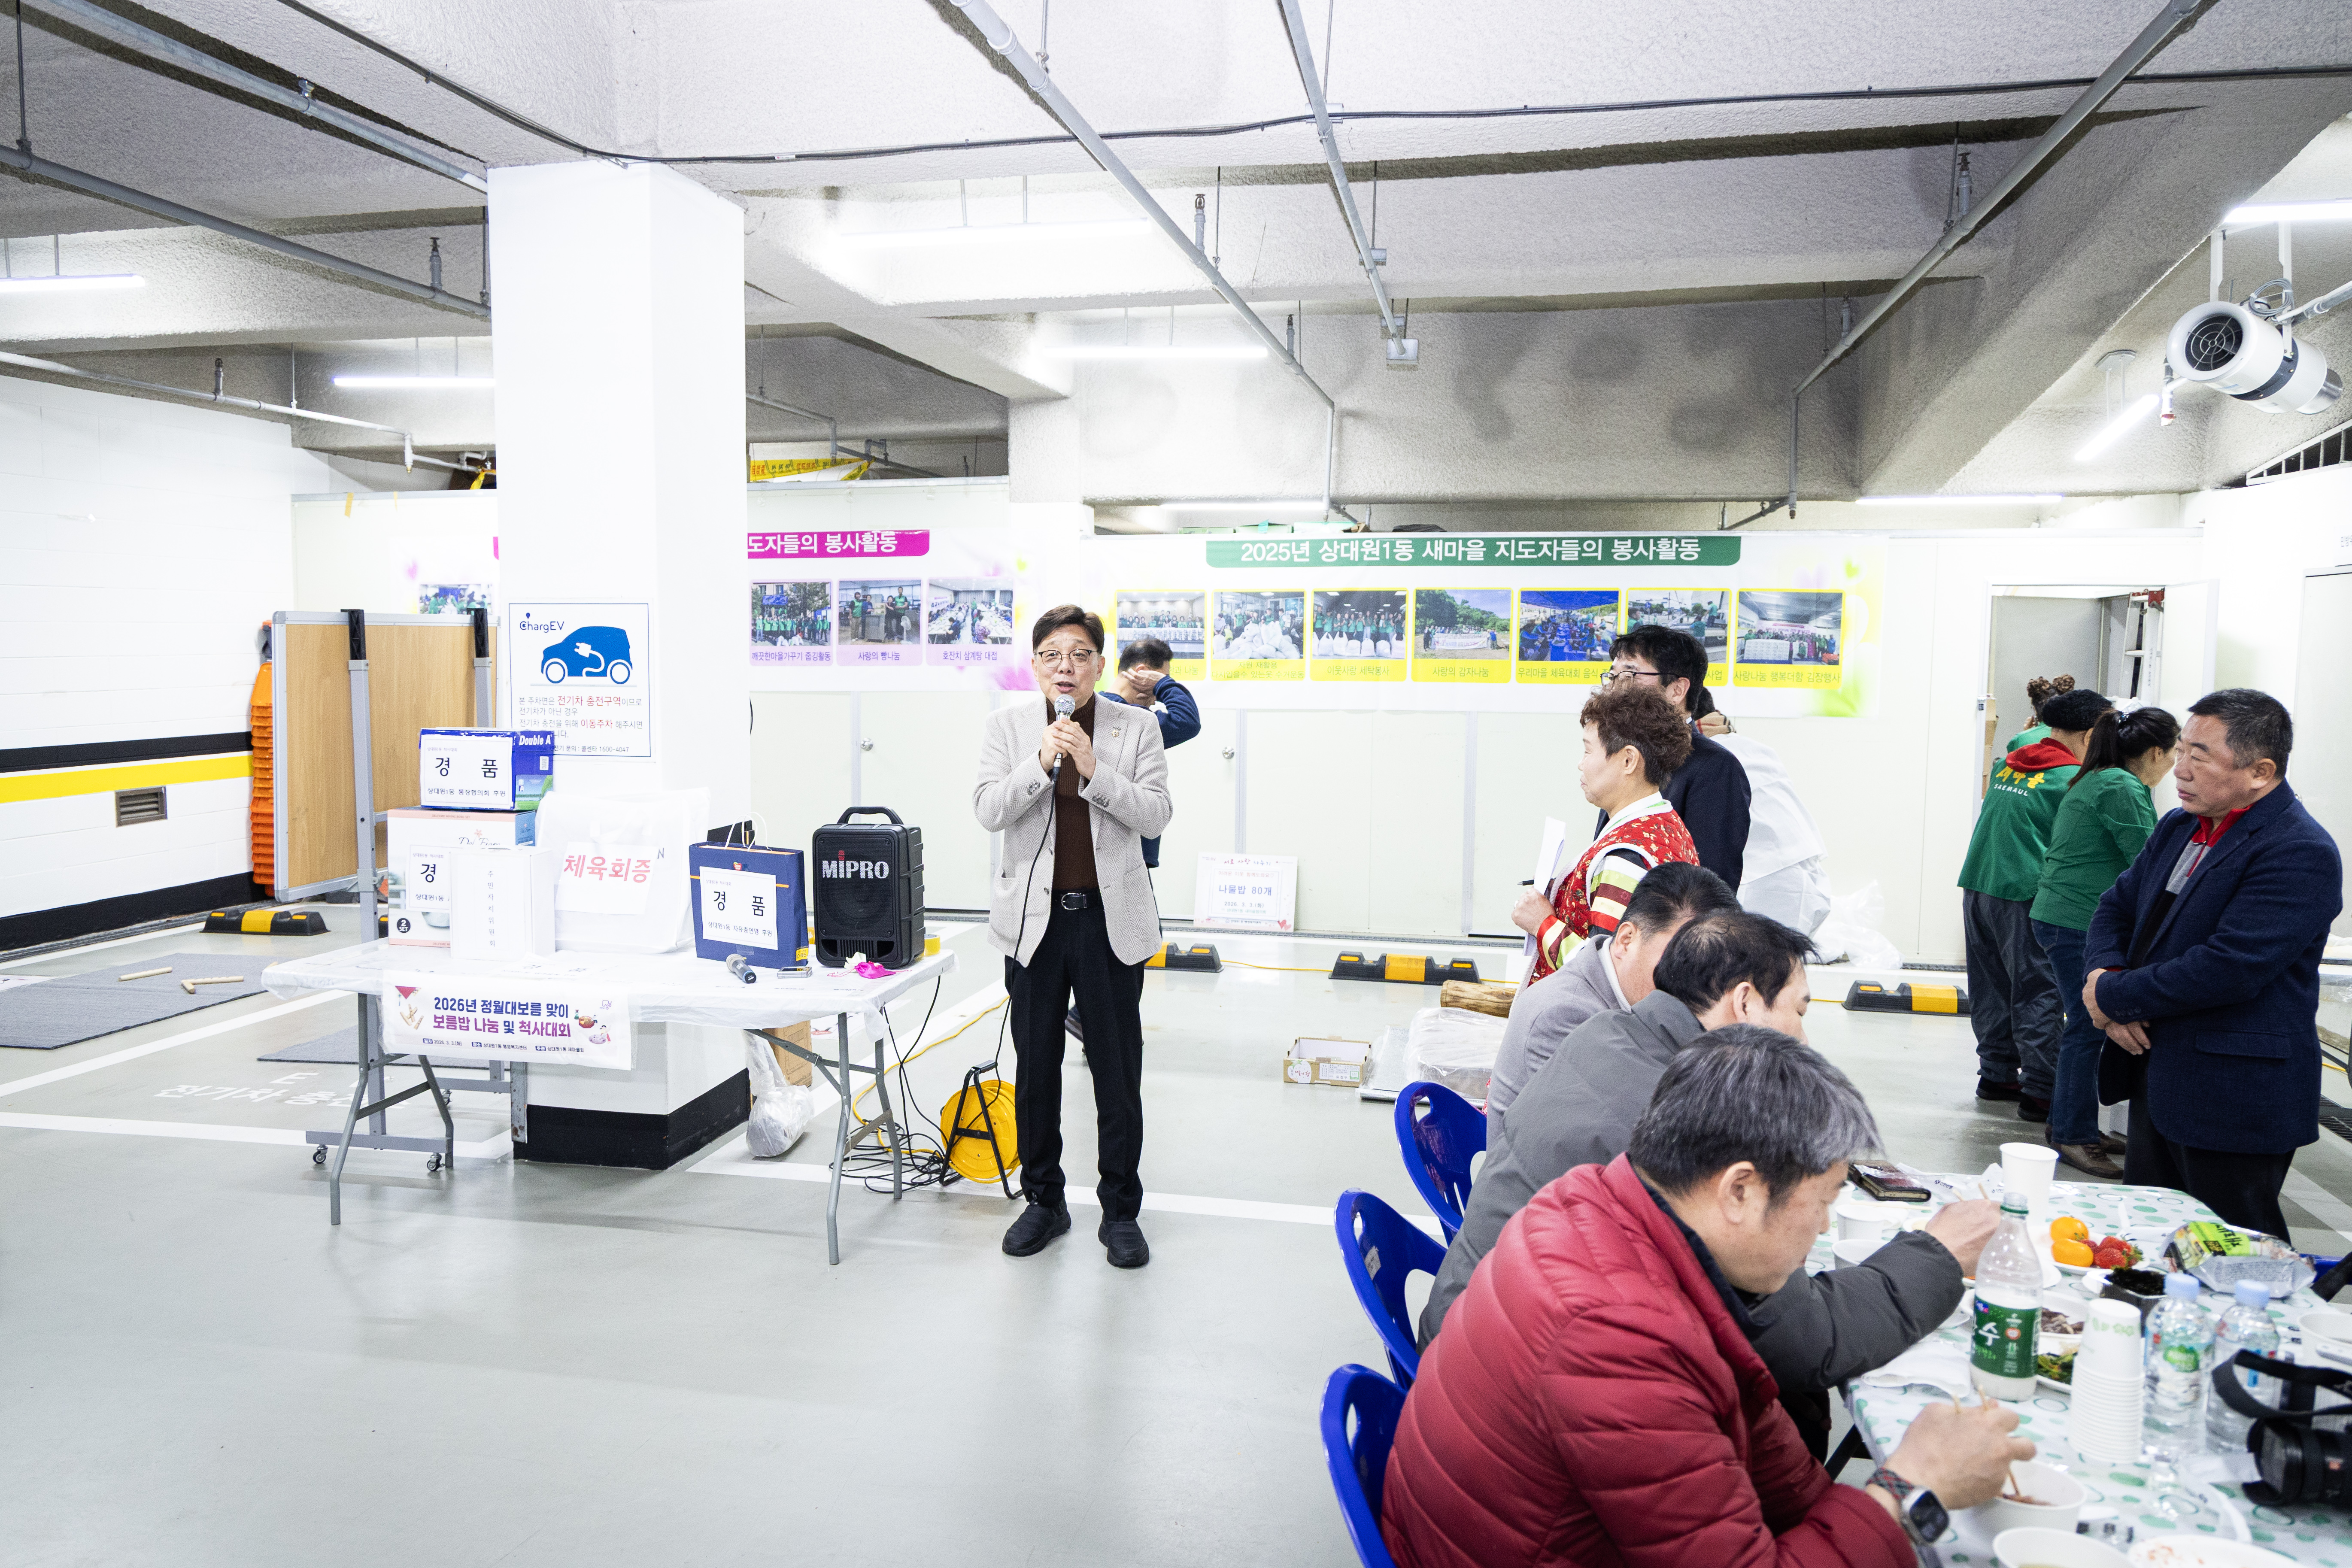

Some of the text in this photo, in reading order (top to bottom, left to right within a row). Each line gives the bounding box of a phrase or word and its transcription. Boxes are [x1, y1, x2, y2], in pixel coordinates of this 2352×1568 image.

[825, 532, 898, 553] 봉사활동
[1241, 538, 1702, 562] 2025년 상대원1동 새마을 지도자들의 봉사활동
[519, 621, 564, 633] ChargEV
[751, 651, 831, 661] 깨끗한마을가꾸기 줍깅활동
[858, 651, 901, 661] 사랑의 빵나눔
[964, 650, 982, 661] 삼계탕
[985, 650, 998, 661] 대접
[1184, 665, 1199, 676] 나눔
[1255, 661, 1278, 669] 재활용
[1327, 665, 1390, 676] 이웃사랑 세탁봉사
[1275, 670, 1305, 679] 수거운동
[1432, 666, 1489, 677] 사랑의 감자나눔
[1518, 667, 1548, 678] 우리마을
[1551, 667, 1581, 679] 체육대회
[1583, 668, 1598, 679] 음식
[1734, 670, 1840, 683] 사랑나눔 행복더함 김장행사
[519, 696, 643, 707] 본 주차면은 전기차 충전구역이므로
[519, 707, 578, 716] 전기차가 아닌 경우
[519, 719, 643, 730] 전기차 충전을 위해 이동주차 해주시면
[519, 735, 551, 746] Double A
[435, 757, 498, 778] 경 품
[1994, 783, 2028, 796] SAEMAUL
[420, 864, 436, 883] 경
[564, 855, 651, 883] 체육회증
[822, 860, 889, 879] MIPRO
[1219, 885, 1272, 896] 나물밥 80개
[713, 891, 765, 917] 경 품
[707, 921, 731, 931] 상대원1동
[434, 996, 569, 1019] 2026년 정월대보름 맞이
[433, 1014, 571, 1037] 보름밥 나눔 및 척사대회
[153, 1084, 290, 1102] 전기차
